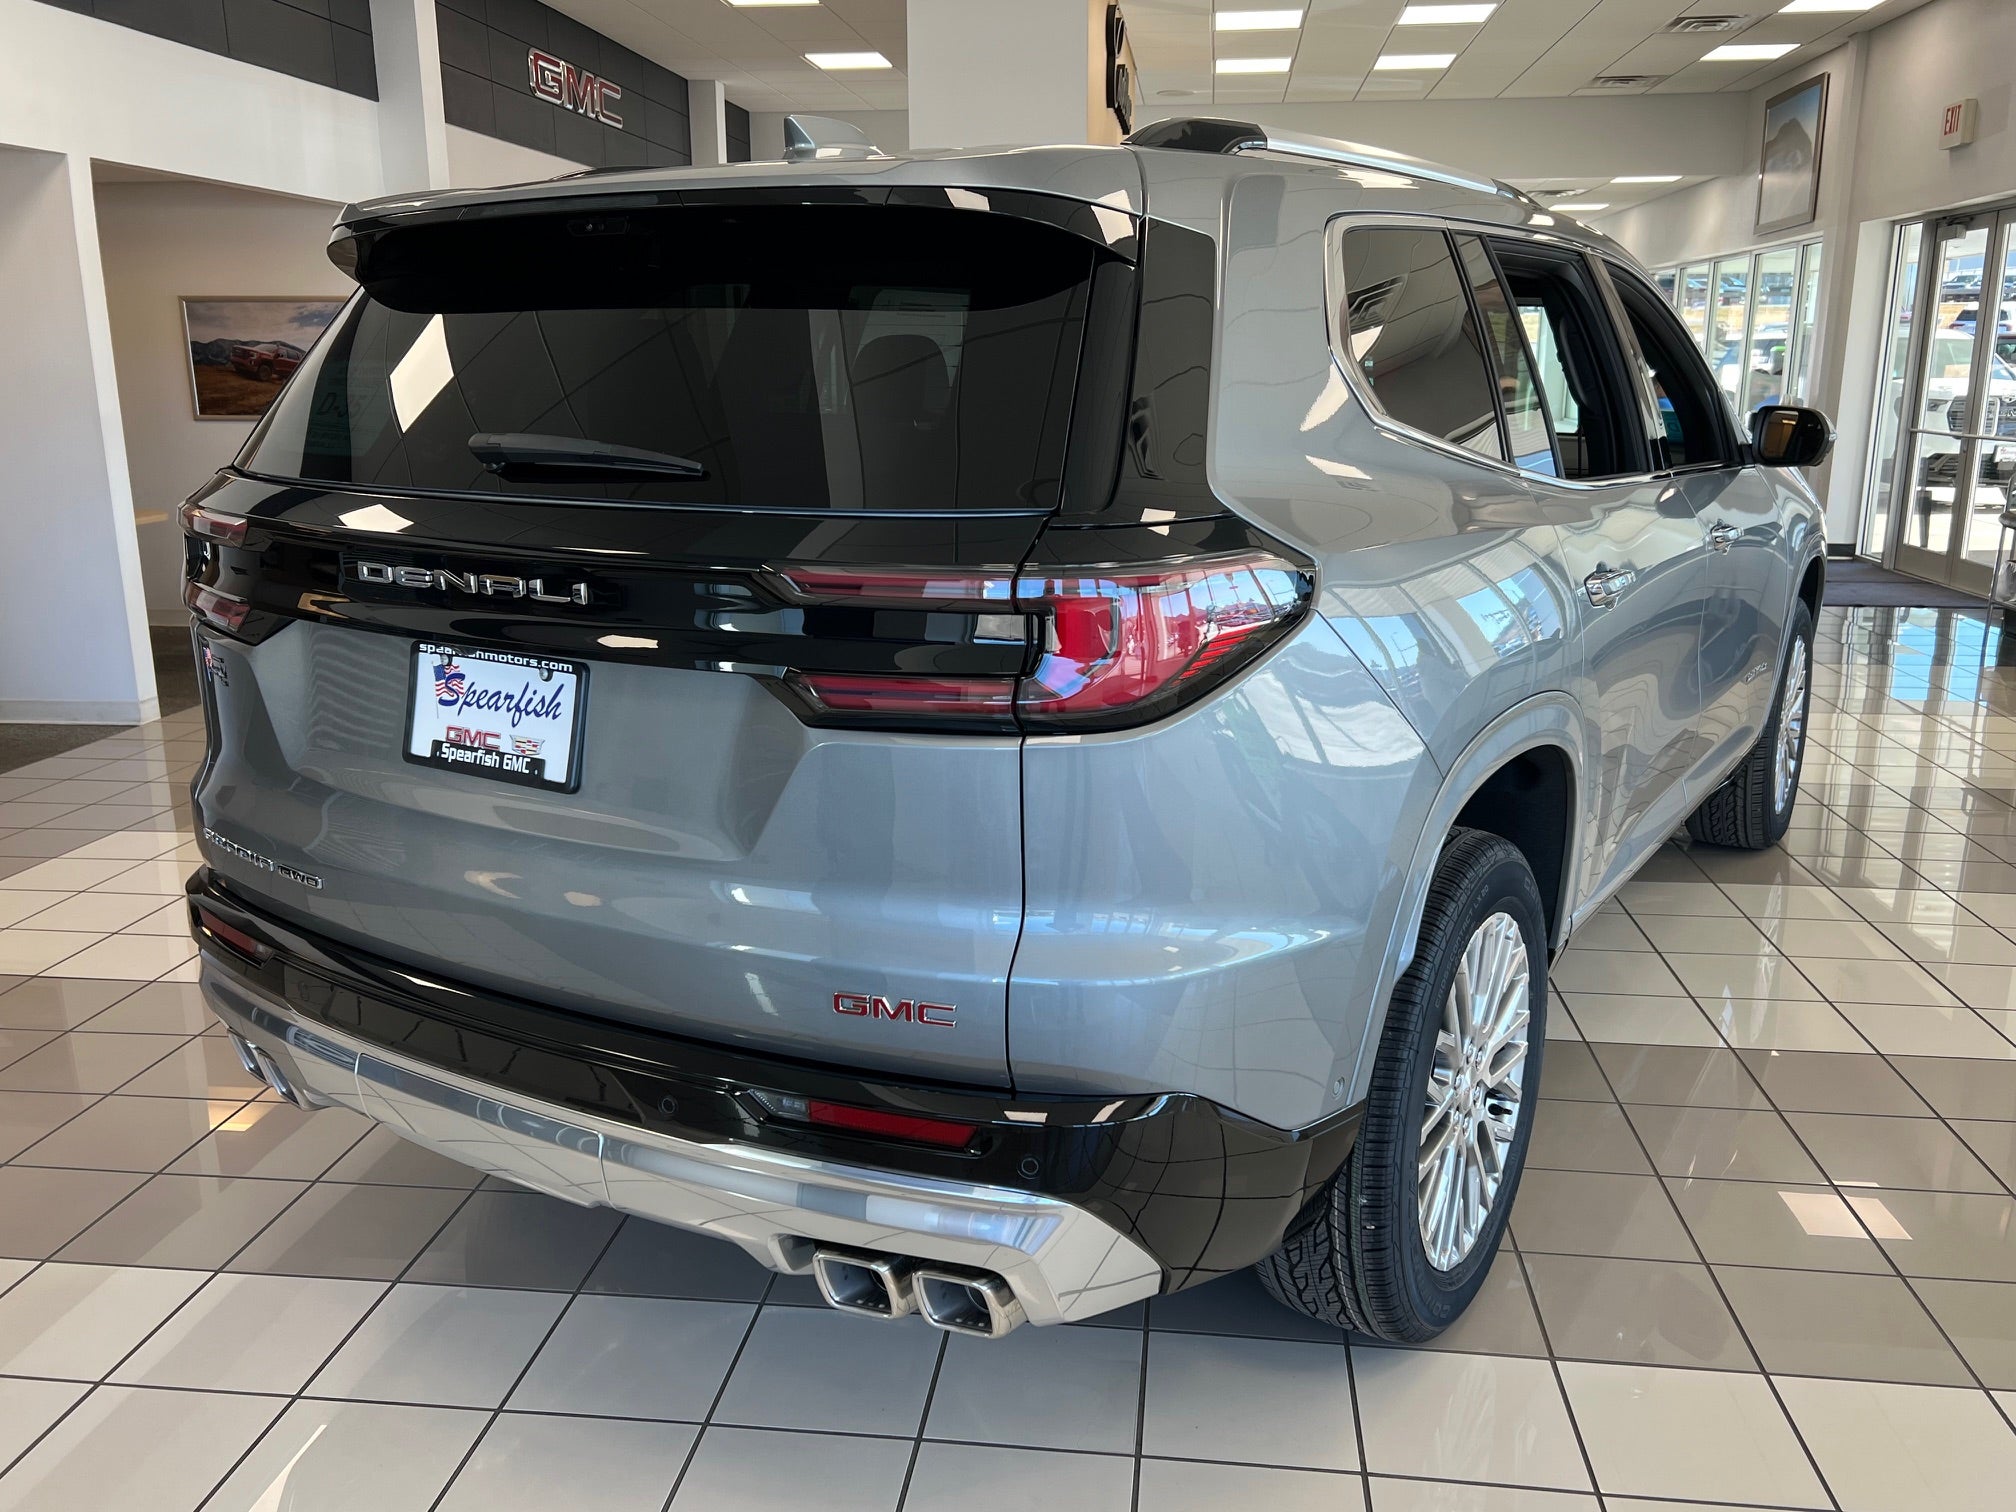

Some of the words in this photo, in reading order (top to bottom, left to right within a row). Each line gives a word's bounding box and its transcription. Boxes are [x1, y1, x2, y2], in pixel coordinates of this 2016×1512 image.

[528, 47, 623, 129] GMC
[1943, 103, 1962, 136] EXIT
[358, 560, 588, 606] DENALI
[418, 643, 573, 673] speahmotors.com
[438, 672, 565, 728] Spearfish
[445, 725, 501, 750] GMC
[440, 743, 500, 768] Spearfish
[503, 757, 531, 774] GMC
[277, 864, 324, 890] AWD
[832, 991, 957, 1029] GMC
